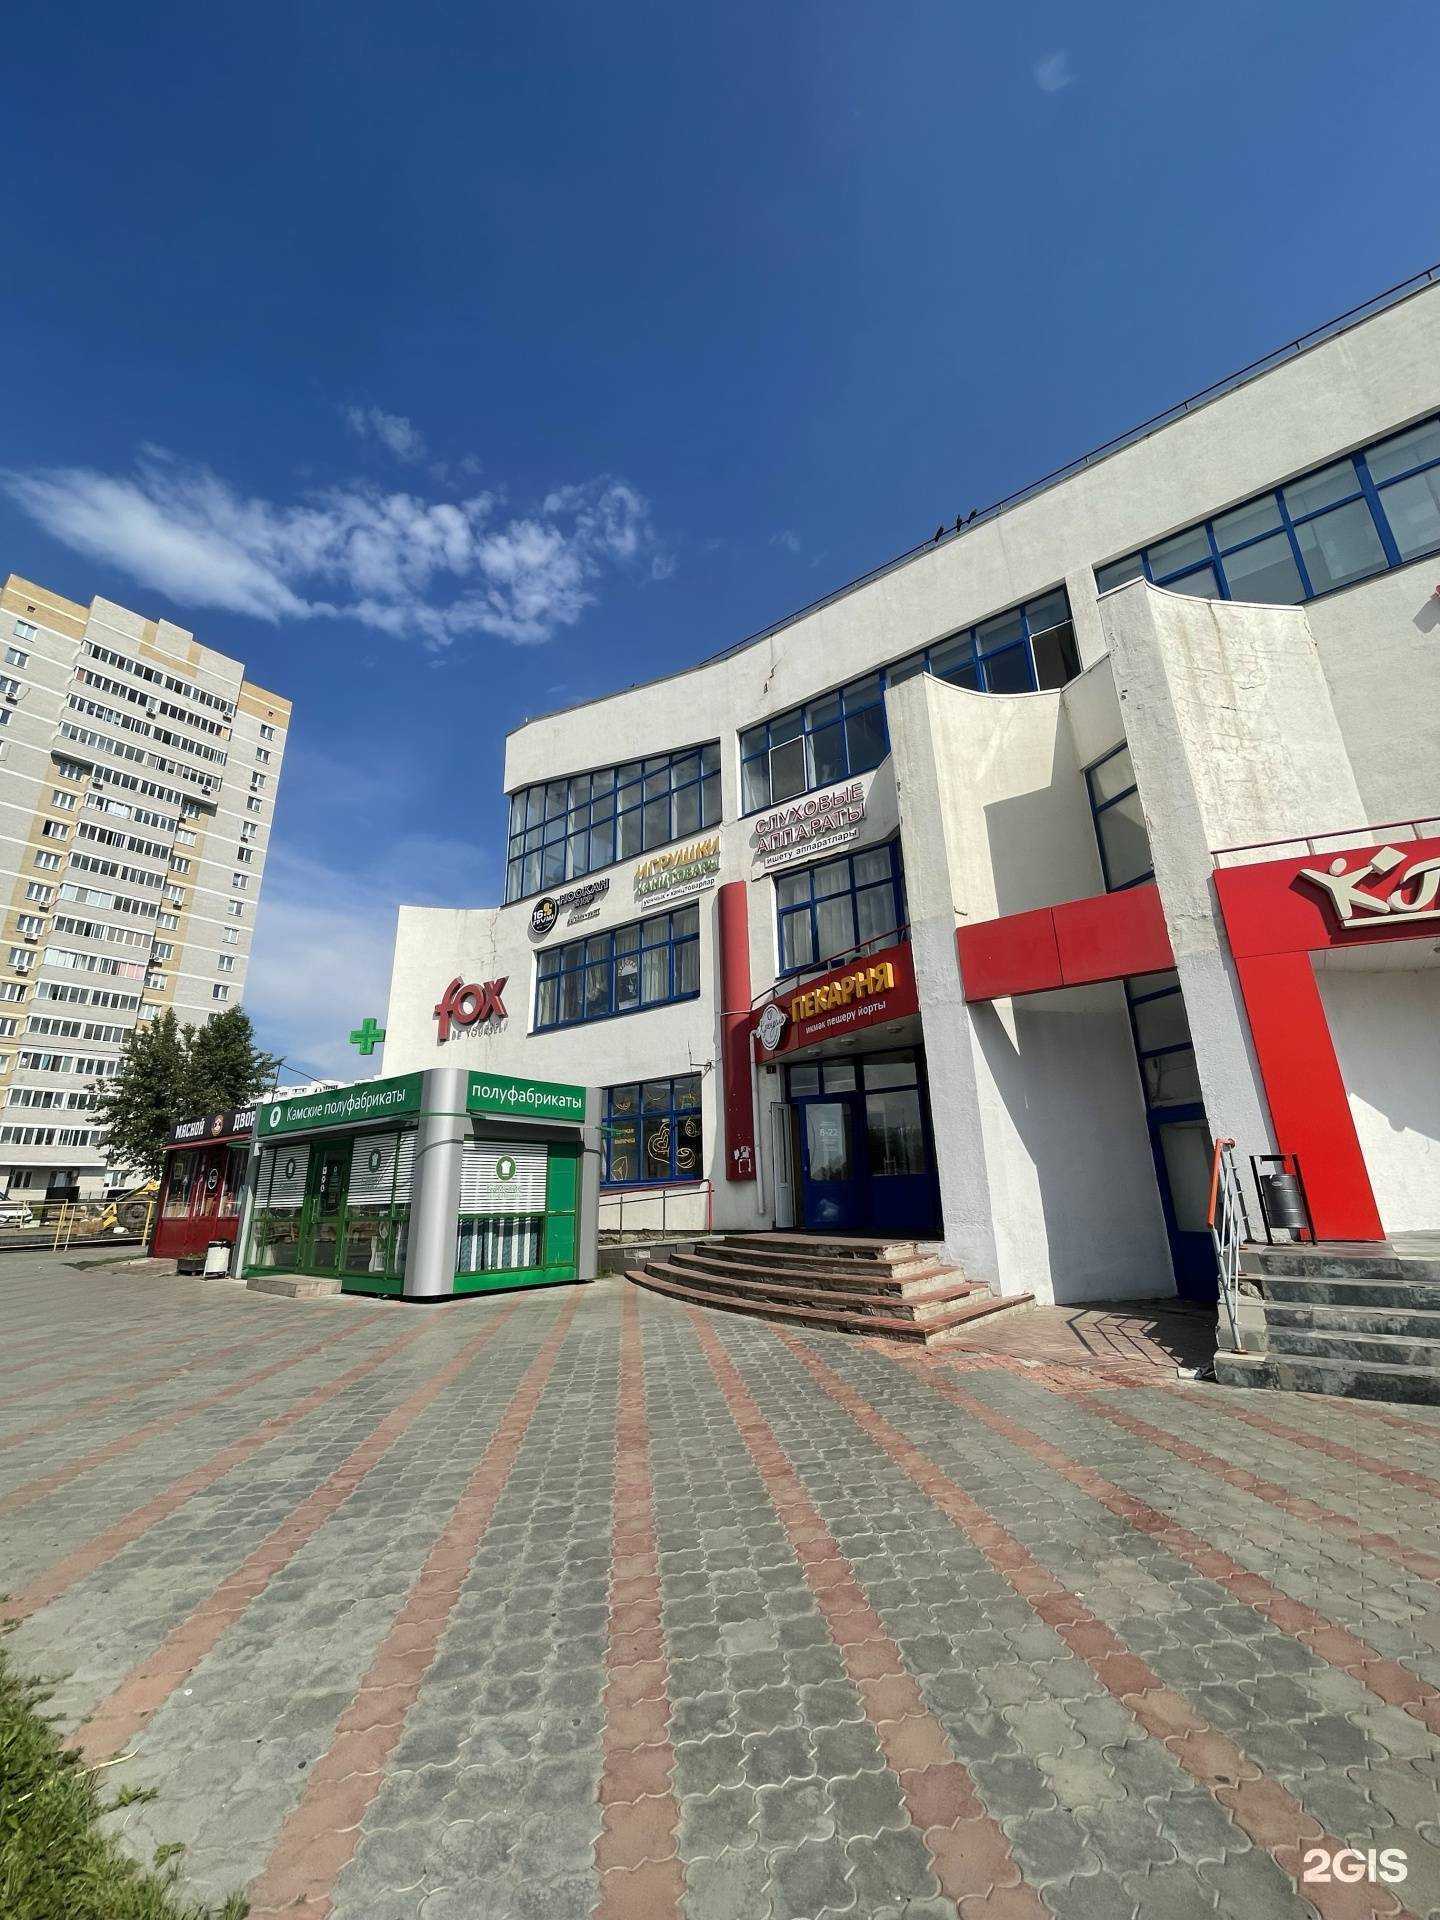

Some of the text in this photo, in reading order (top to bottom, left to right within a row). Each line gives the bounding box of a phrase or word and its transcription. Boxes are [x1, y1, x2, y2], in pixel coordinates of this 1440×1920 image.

[755, 782, 864, 834] СЛУХОВЫЕ
[757, 803, 865, 852] АППАРАТЫ
[796, 829, 857, 855] аппаратлары
[632, 836, 720, 879] ИГРУШКИ
[560, 878, 611, 905] HOOKAH
[533, 910, 544, 920] 16
[791, 962, 895, 1023] ПЕКАРНЯ
[858, 1000, 886, 1017] йорты
[286, 1089, 406, 1122] Камские полуфабрикаты
[472, 1085, 582, 1109] полуфабрикаты
[175, 1117, 205, 1139] МЯСНОЙ
